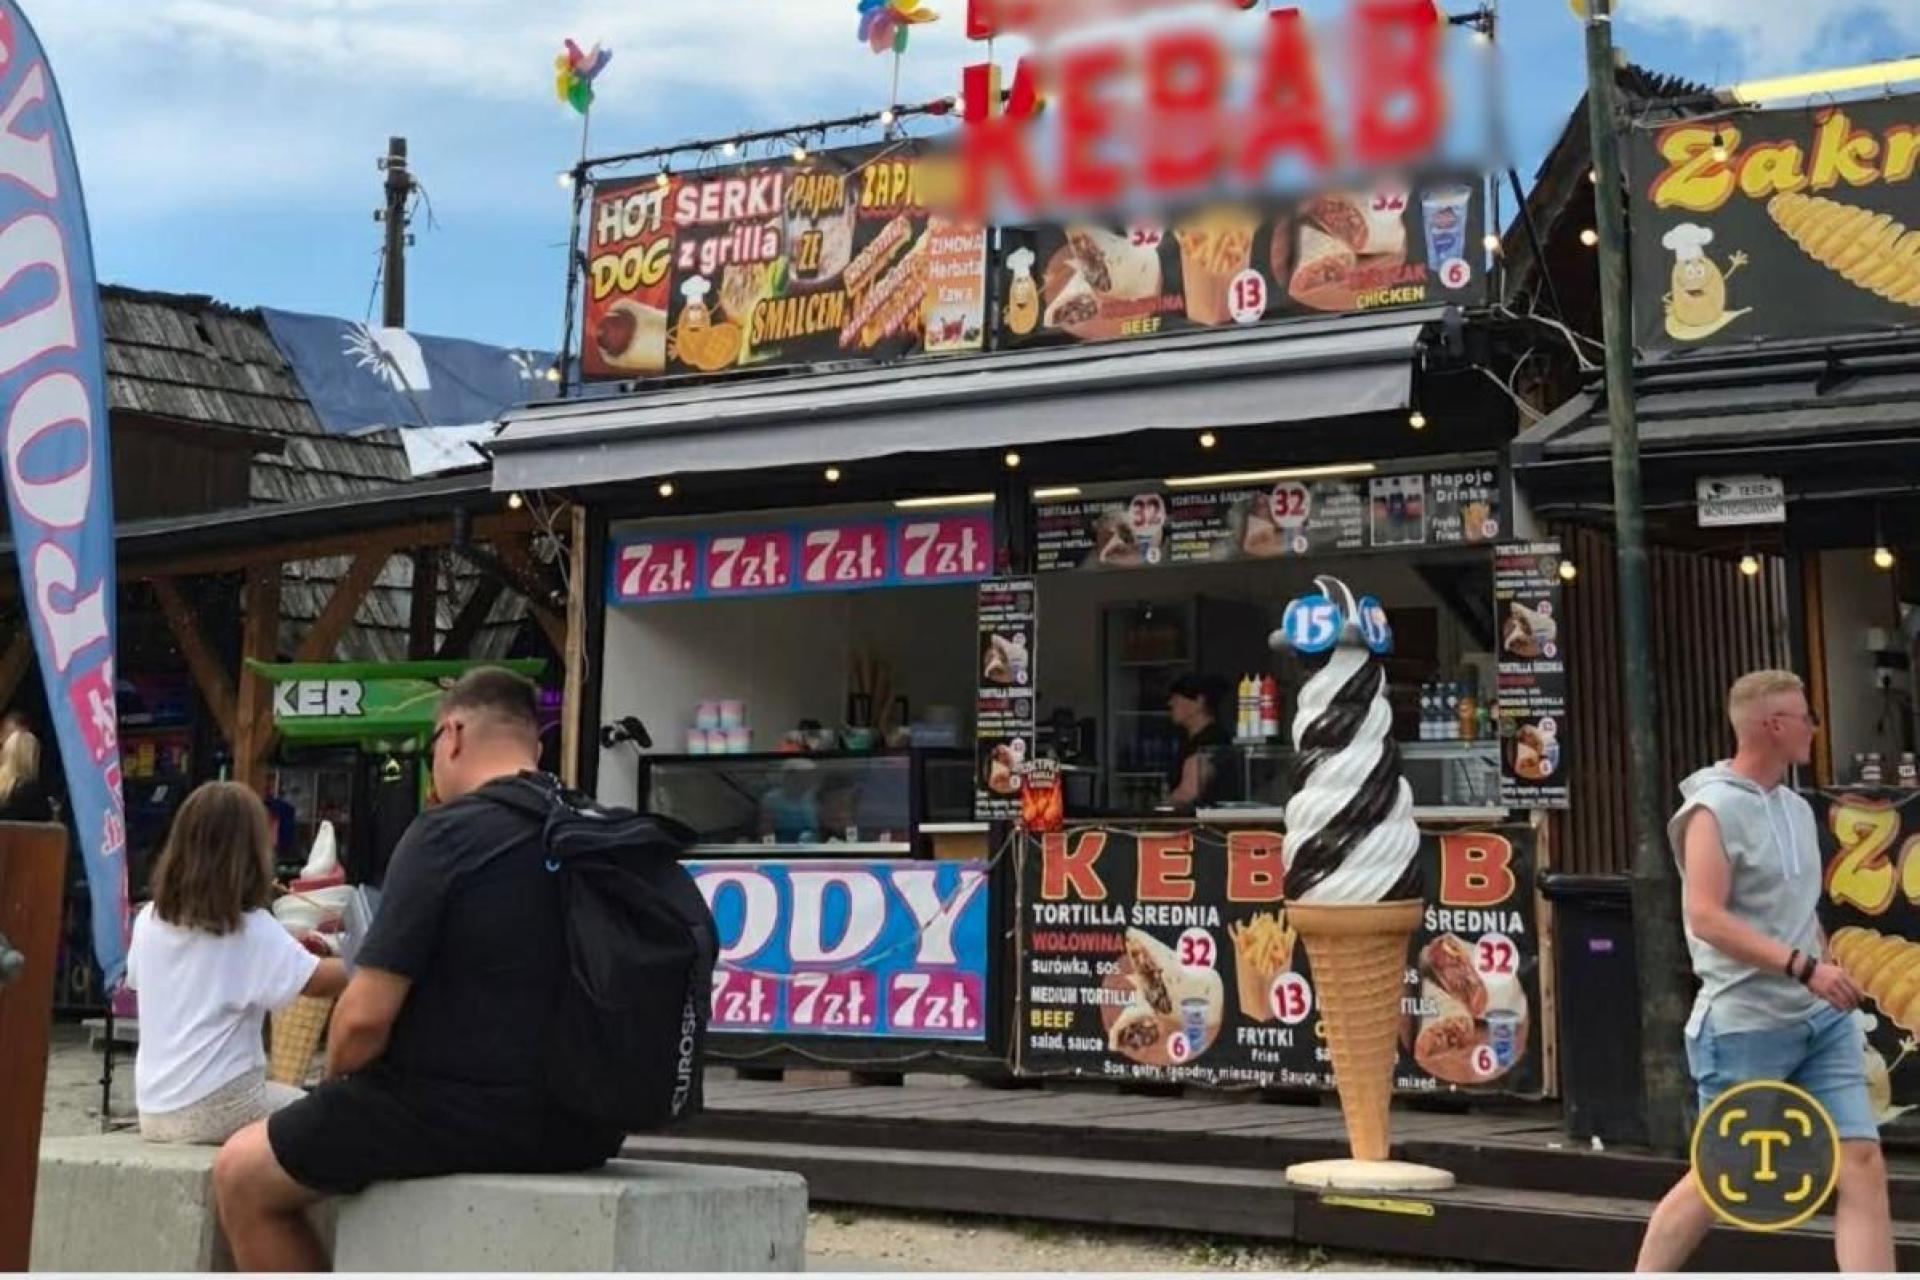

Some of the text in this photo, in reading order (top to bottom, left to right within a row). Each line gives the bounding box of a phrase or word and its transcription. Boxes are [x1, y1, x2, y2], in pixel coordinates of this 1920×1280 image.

[673, 172, 784, 226] SERKI
[597, 189, 667, 246] HOT
[678, 224, 778, 275] z grilla
[799, 231, 823, 270] ZE
[591, 237, 671, 299] DOG
[1448, 264, 1463, 283] 6
[1235, 280, 1262, 310] 13
[1355, 285, 1425, 309] CHICKEN
[1430, 469, 1493, 488] Napoje
[1133, 500, 1161, 527] 32
[1275, 488, 1306, 516] 32
[1295, 605, 1335, 645] 15
[274, 679, 363, 717] KER
[1041, 831, 1516, 906] KEBB
[1032, 900, 1221, 926] TORTILLA ŚREDNIA
[1424, 904, 1524, 933] ŚREDNIA
[1181, 936, 1211, 967] 32
[1479, 941, 1513, 974] 32
[1031, 955, 1121, 977] surówka, sos
[1030, 986, 1137, 1006] MEDIUM TORTILLA
[1275, 982, 1306, 1018] 13
[1030, 1008, 1074, 1028] BEEF
[1068, 1037, 1104, 1051] sauce
[1173, 1037, 1186, 1057] 6
[1237, 1026, 1294, 1047] FRYTKI
[1251, 1047, 1280, 1063] Fries
[1478, 1051, 1492, 1071] 6
[1398, 1075, 1437, 1089] mixed
